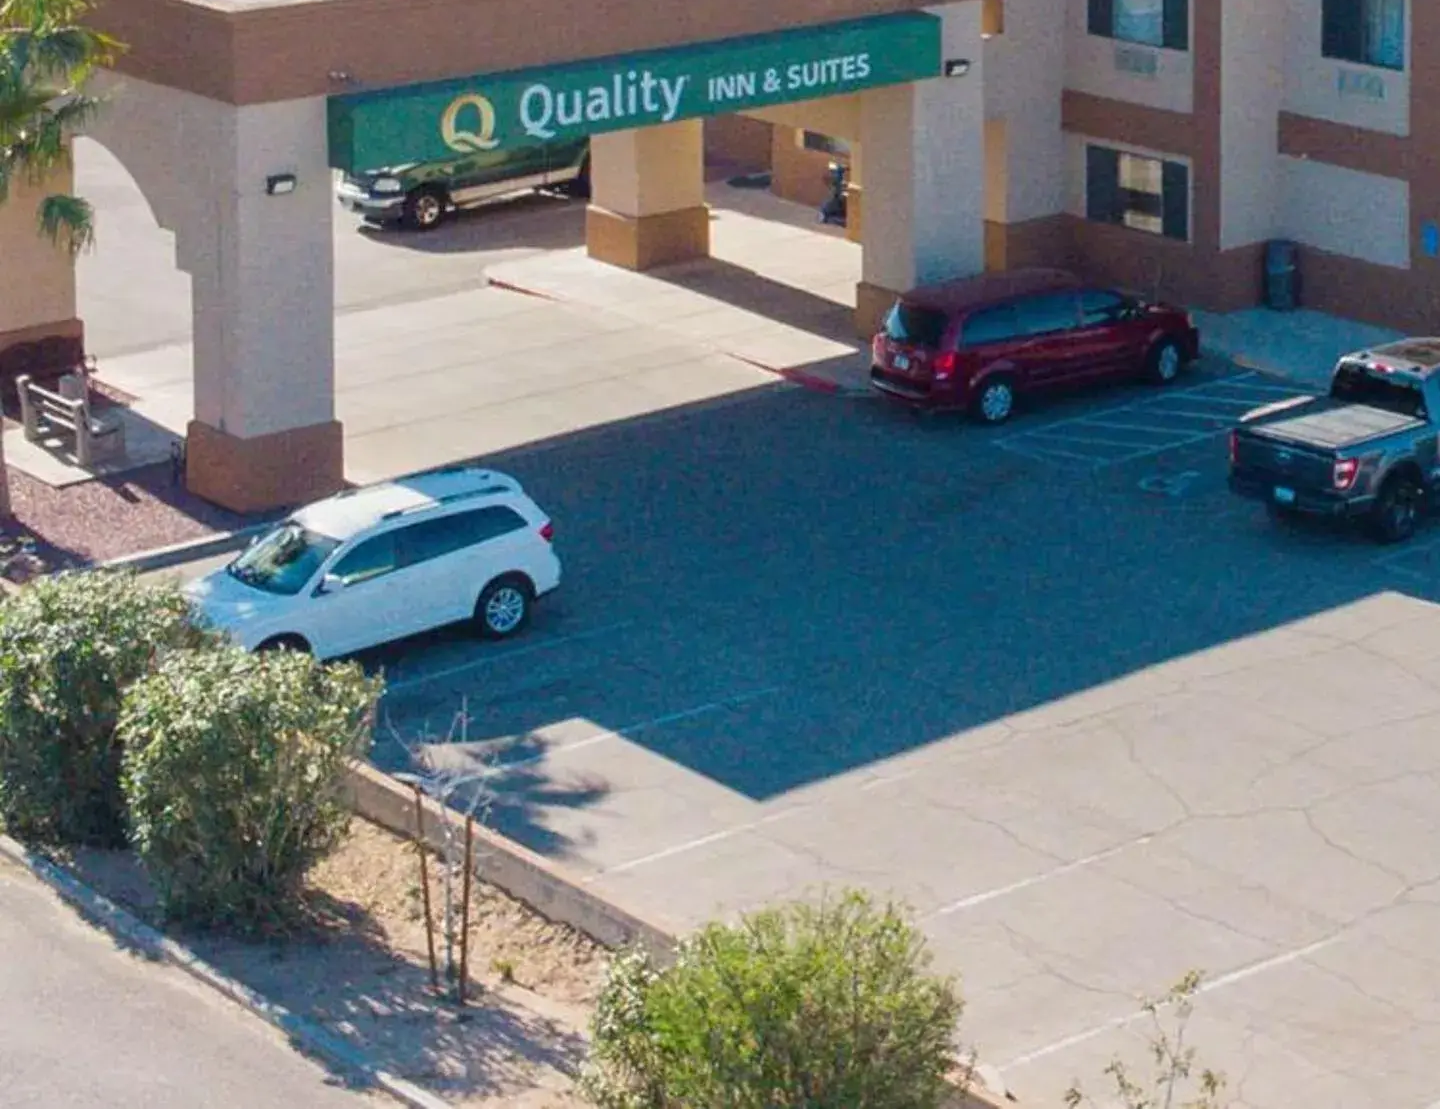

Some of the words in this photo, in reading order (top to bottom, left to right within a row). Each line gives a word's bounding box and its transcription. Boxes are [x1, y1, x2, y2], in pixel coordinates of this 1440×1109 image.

[441, 94, 499, 153] Q
[519, 70, 685, 138] Quality
[708, 72, 756, 102] INN
[763, 68, 781, 93] &
[787, 53, 871, 90] SUITES
